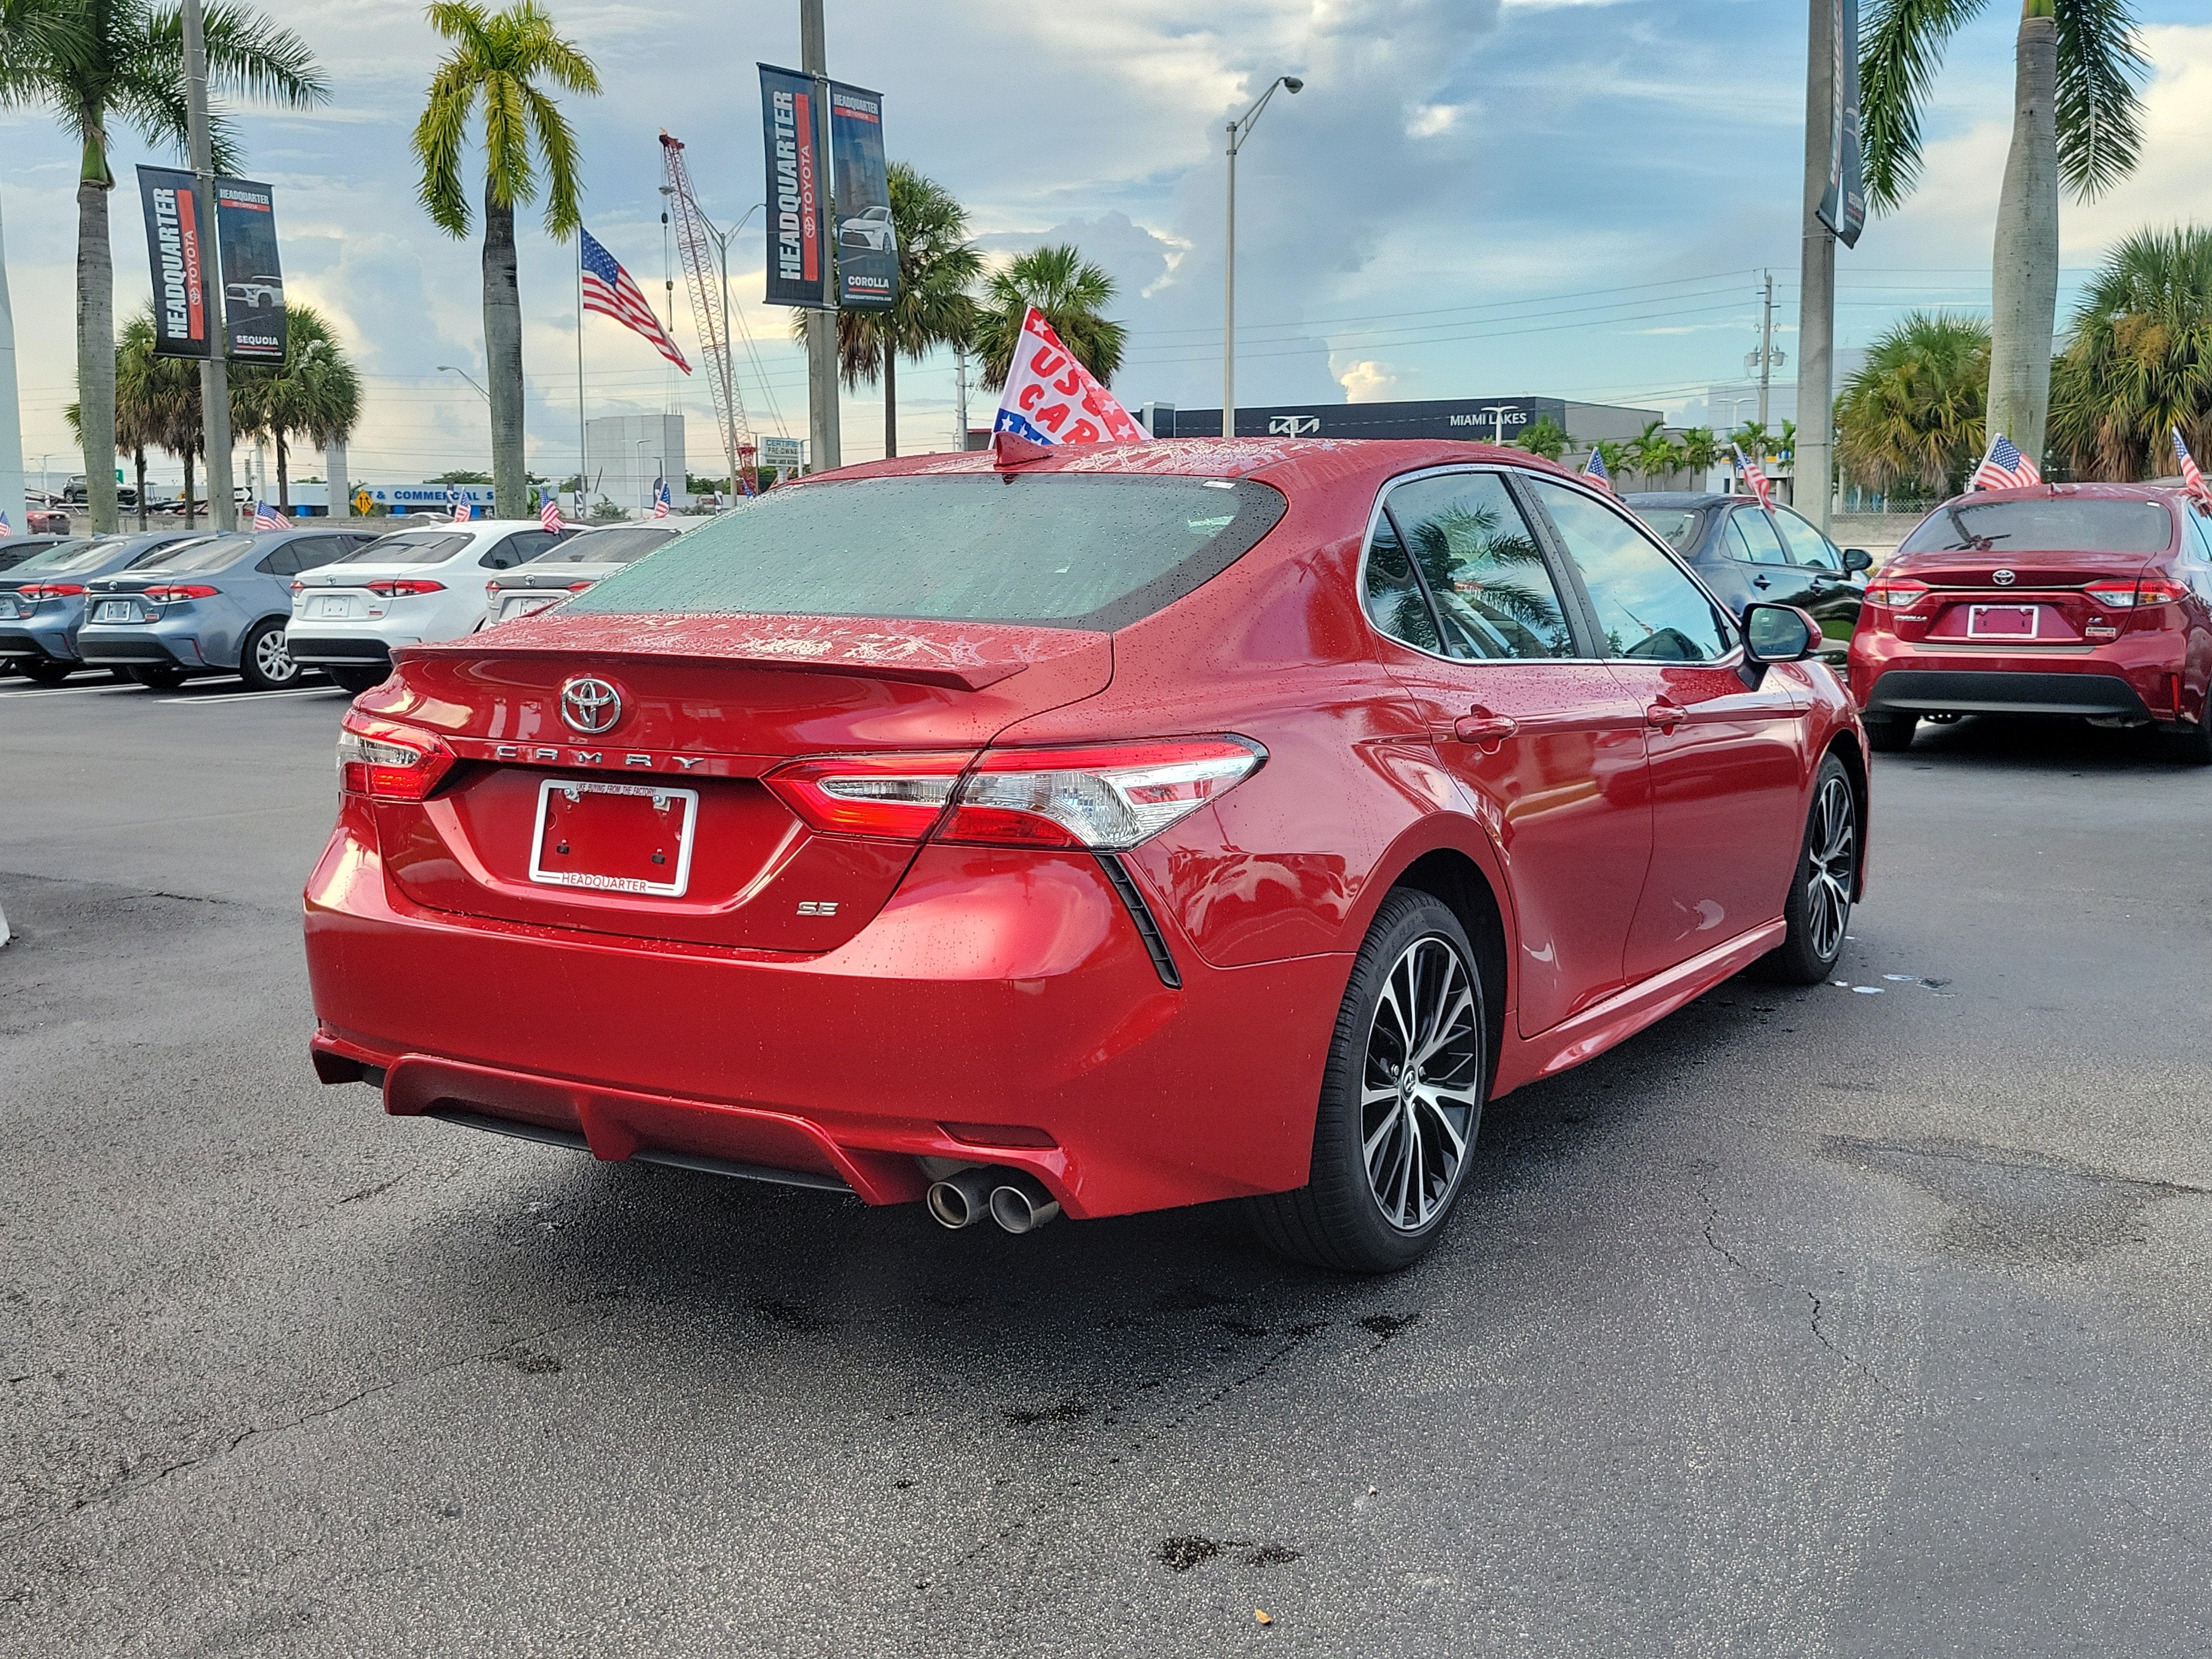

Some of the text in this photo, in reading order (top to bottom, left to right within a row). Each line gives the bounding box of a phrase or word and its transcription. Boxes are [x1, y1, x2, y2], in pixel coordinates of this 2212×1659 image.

[833, 94, 878, 115] HEADQUARTER
[774, 91, 801, 280] HEADQUARTER
[800, 145, 814, 217] TOYOTA
[219, 188, 269, 205] HEADQUARTER
[154, 188, 188, 339] HEADQUARTER
[184, 230, 199, 285] TOYOTA
[848, 276, 889, 289] COROLLA
[236, 335, 279, 346] SEQUOIA
[1269, 418, 1319, 434] KIA
[1450, 414, 1486, 426] MIAMI
[376, 490, 386, 500] &
[394, 490, 479, 500] COMMERCAL
[496, 745, 705, 769] CAMRY
[577, 783, 586, 791] LIKE
[588, 784, 605, 793] BUYING
[607, 785, 621, 794] FROM
[623, 786, 631, 794] THE
[562, 873, 646, 891] HEADQUARTER
[796, 901, 839, 916] SE
